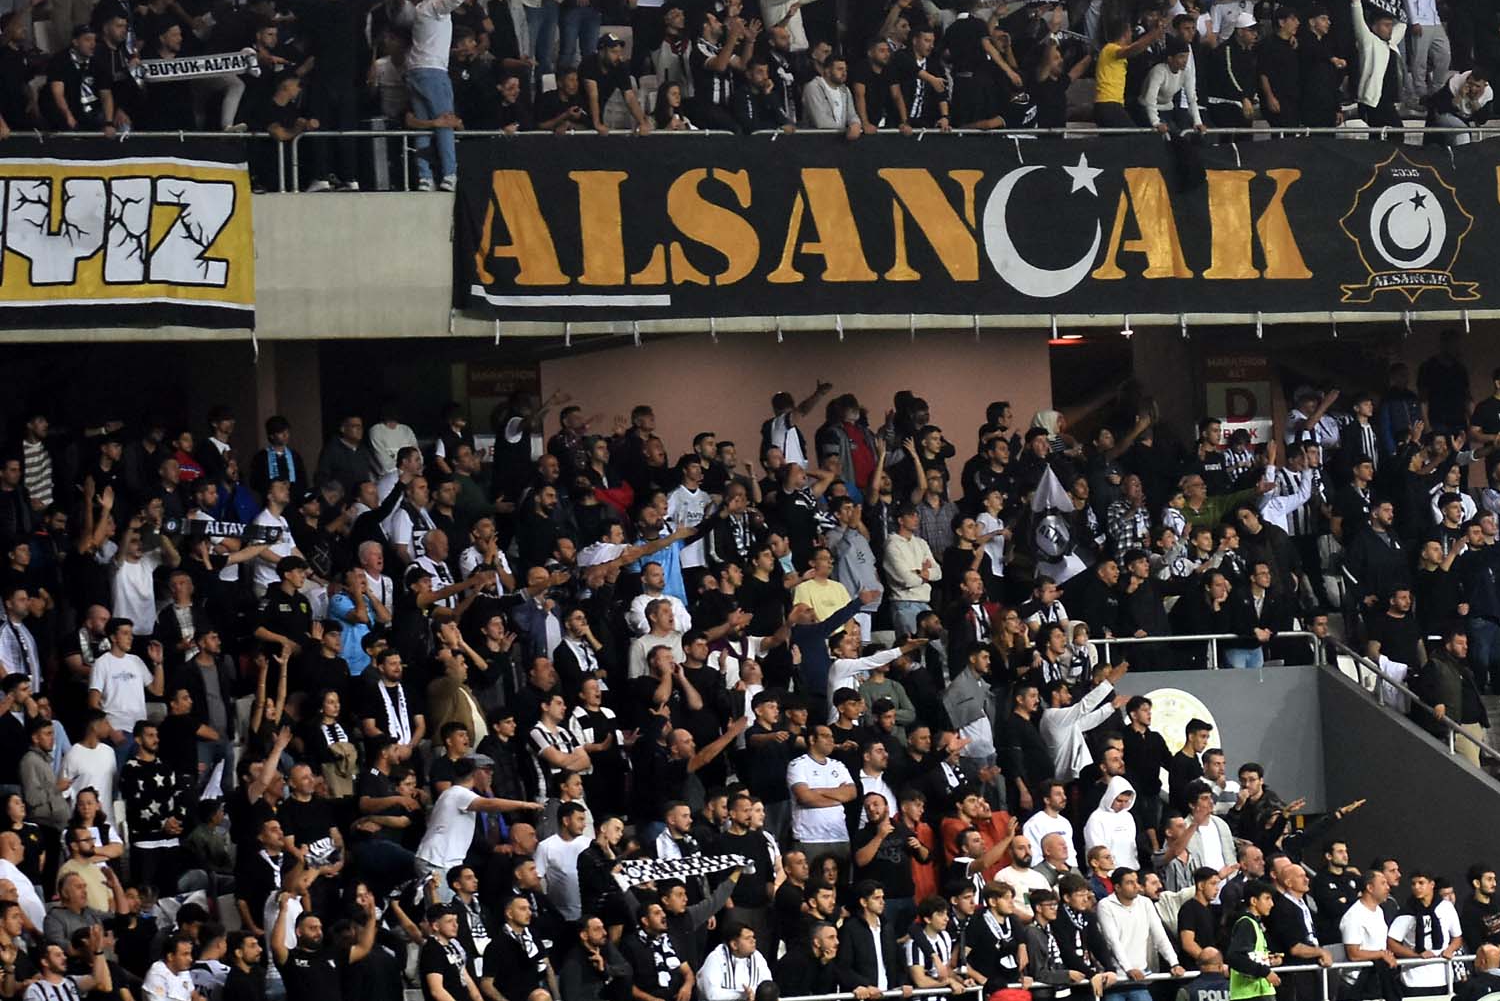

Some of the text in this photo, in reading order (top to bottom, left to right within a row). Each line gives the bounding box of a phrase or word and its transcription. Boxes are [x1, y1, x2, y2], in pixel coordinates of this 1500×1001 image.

[3, 175, 236, 288] YIZ
[1225, 387, 1257, 423] D
[1223, 427, 1258, 439] BK
[204, 520, 247, 536] ALTAY
